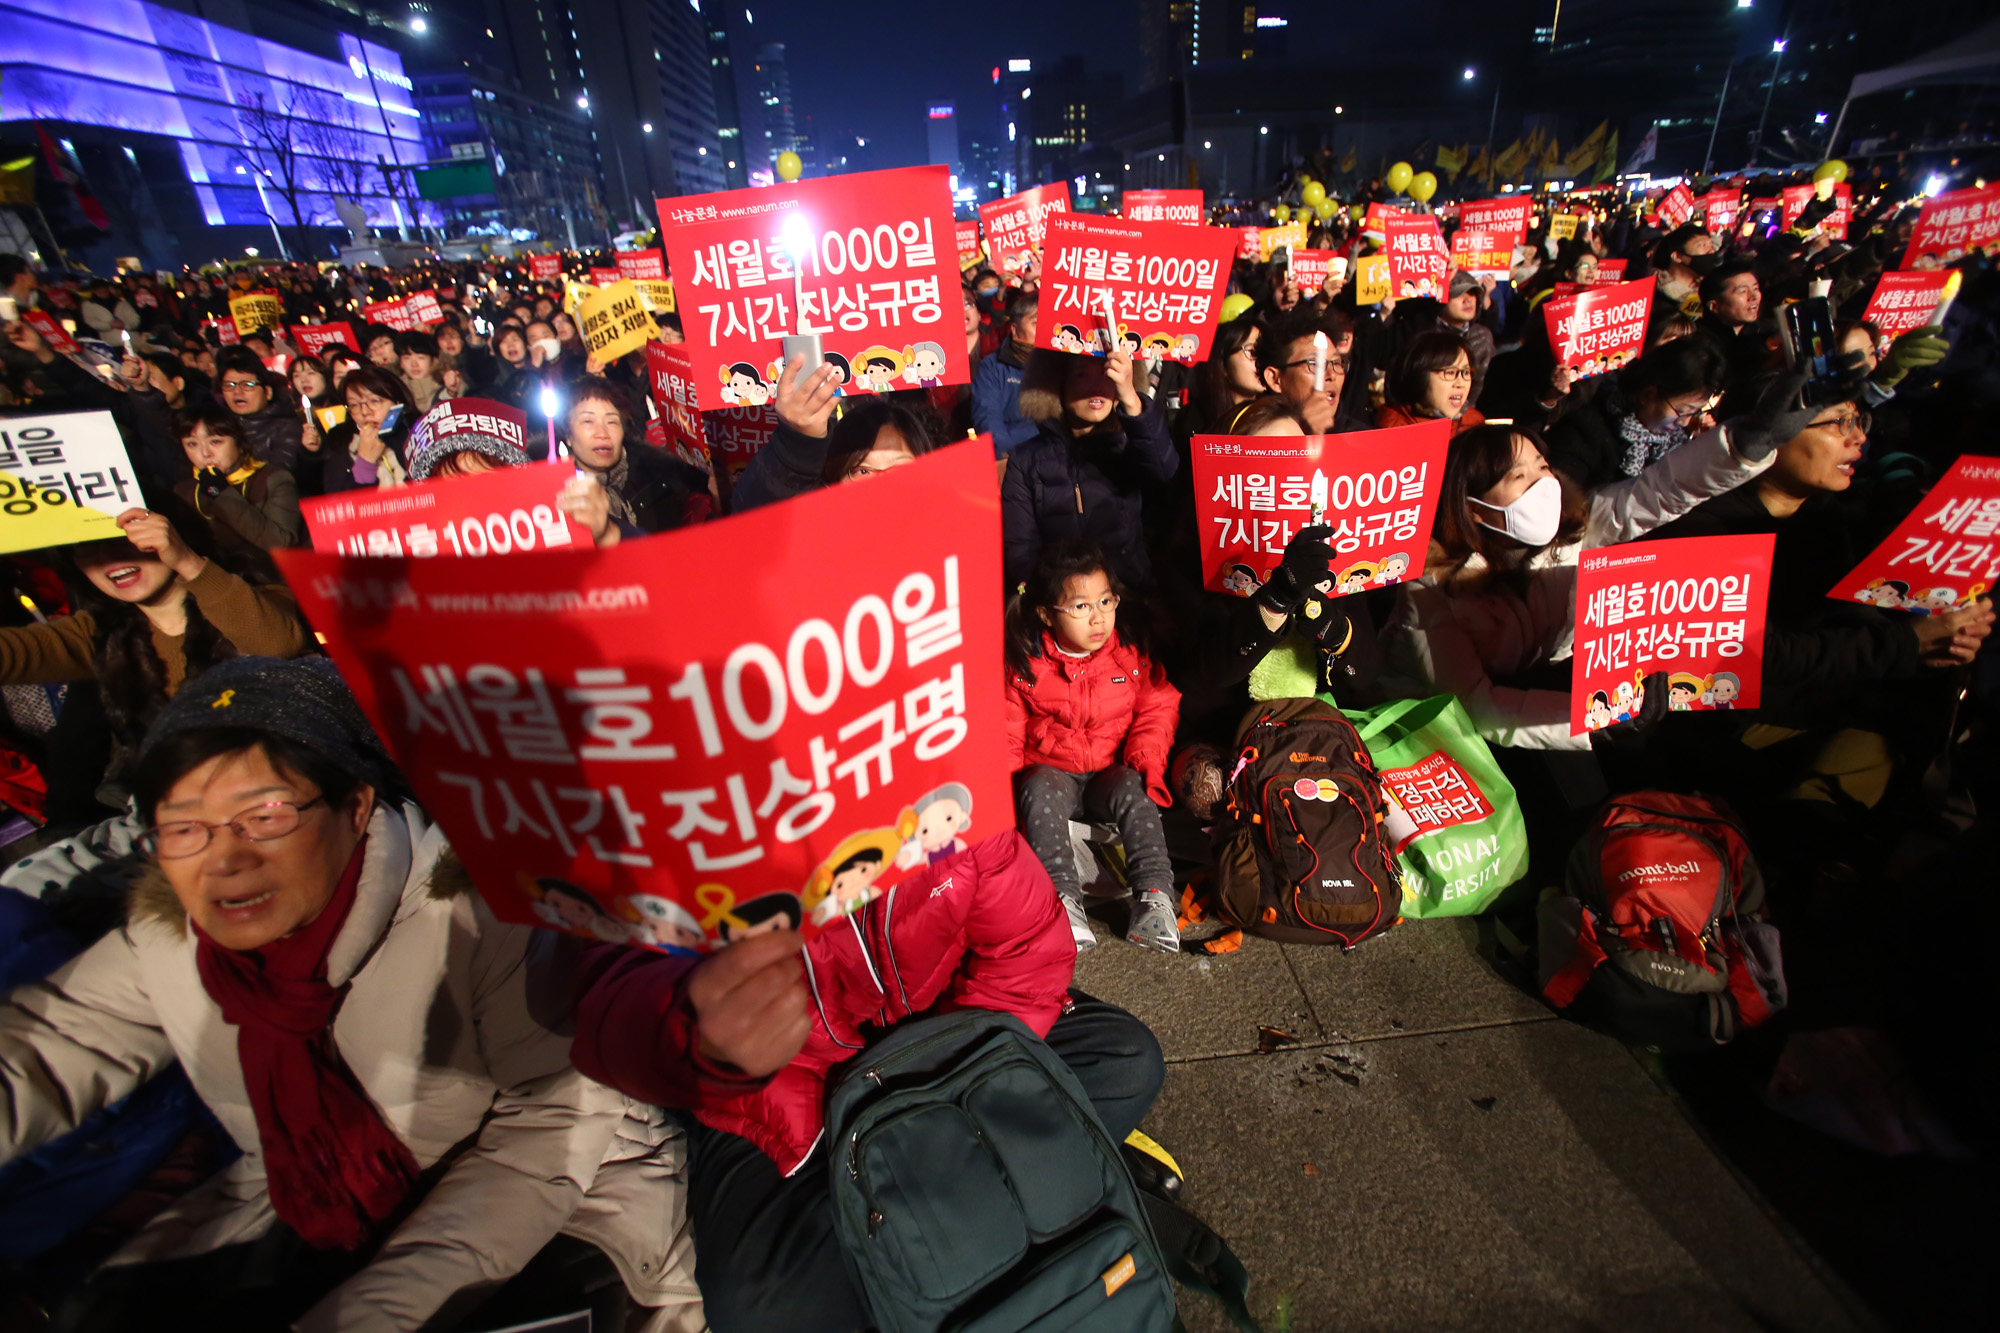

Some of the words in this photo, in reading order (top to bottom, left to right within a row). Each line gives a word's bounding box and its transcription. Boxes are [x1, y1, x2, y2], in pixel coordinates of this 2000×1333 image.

[671, 205, 718, 223] 나눔문화
[720, 200, 799, 219] www.nanum.com
[1087, 225, 1142, 238] www.nanum.com
[1054, 246, 1132, 282] 세월호
[1135, 255, 1219, 290] 1000일
[699, 292, 790, 347] 7시간
[800, 275, 942, 336] 진상규명
[1052, 283, 1115, 317] 7시간
[1120, 290, 1212, 324] 진상규명
[1598, 321, 1644, 351] 진상규명
[1204, 444, 1242, 455] 나눔문화
[1244, 447, 1319, 457] www.nanum.com
[1212, 473, 1311, 512] 세월호
[1213, 517, 1292, 555] 7시간
[1608, 554, 1656, 567] www.nanum.com
[1584, 582, 1646, 628] 세월호
[1649, 574, 1750, 616] 1000일
[669, 556, 965, 759] 1000일
[1584, 629, 1631, 678] 7시간
[1635, 619, 1745, 664] 진상규명
[438, 769, 653, 868] 7시간
[661, 664, 969, 871] 진상규명
[1388, 769, 1421, 781] 인간답게
[1421, 755, 1446, 775] 삽시다
[1408, 791, 1485, 825] 폐하라
[1322, 879, 1342, 888] NOVA
[1343, 879, 1354, 888] 18L
[1651, 962, 1671, 973] EVO
[1673, 967, 1685, 976] 20
